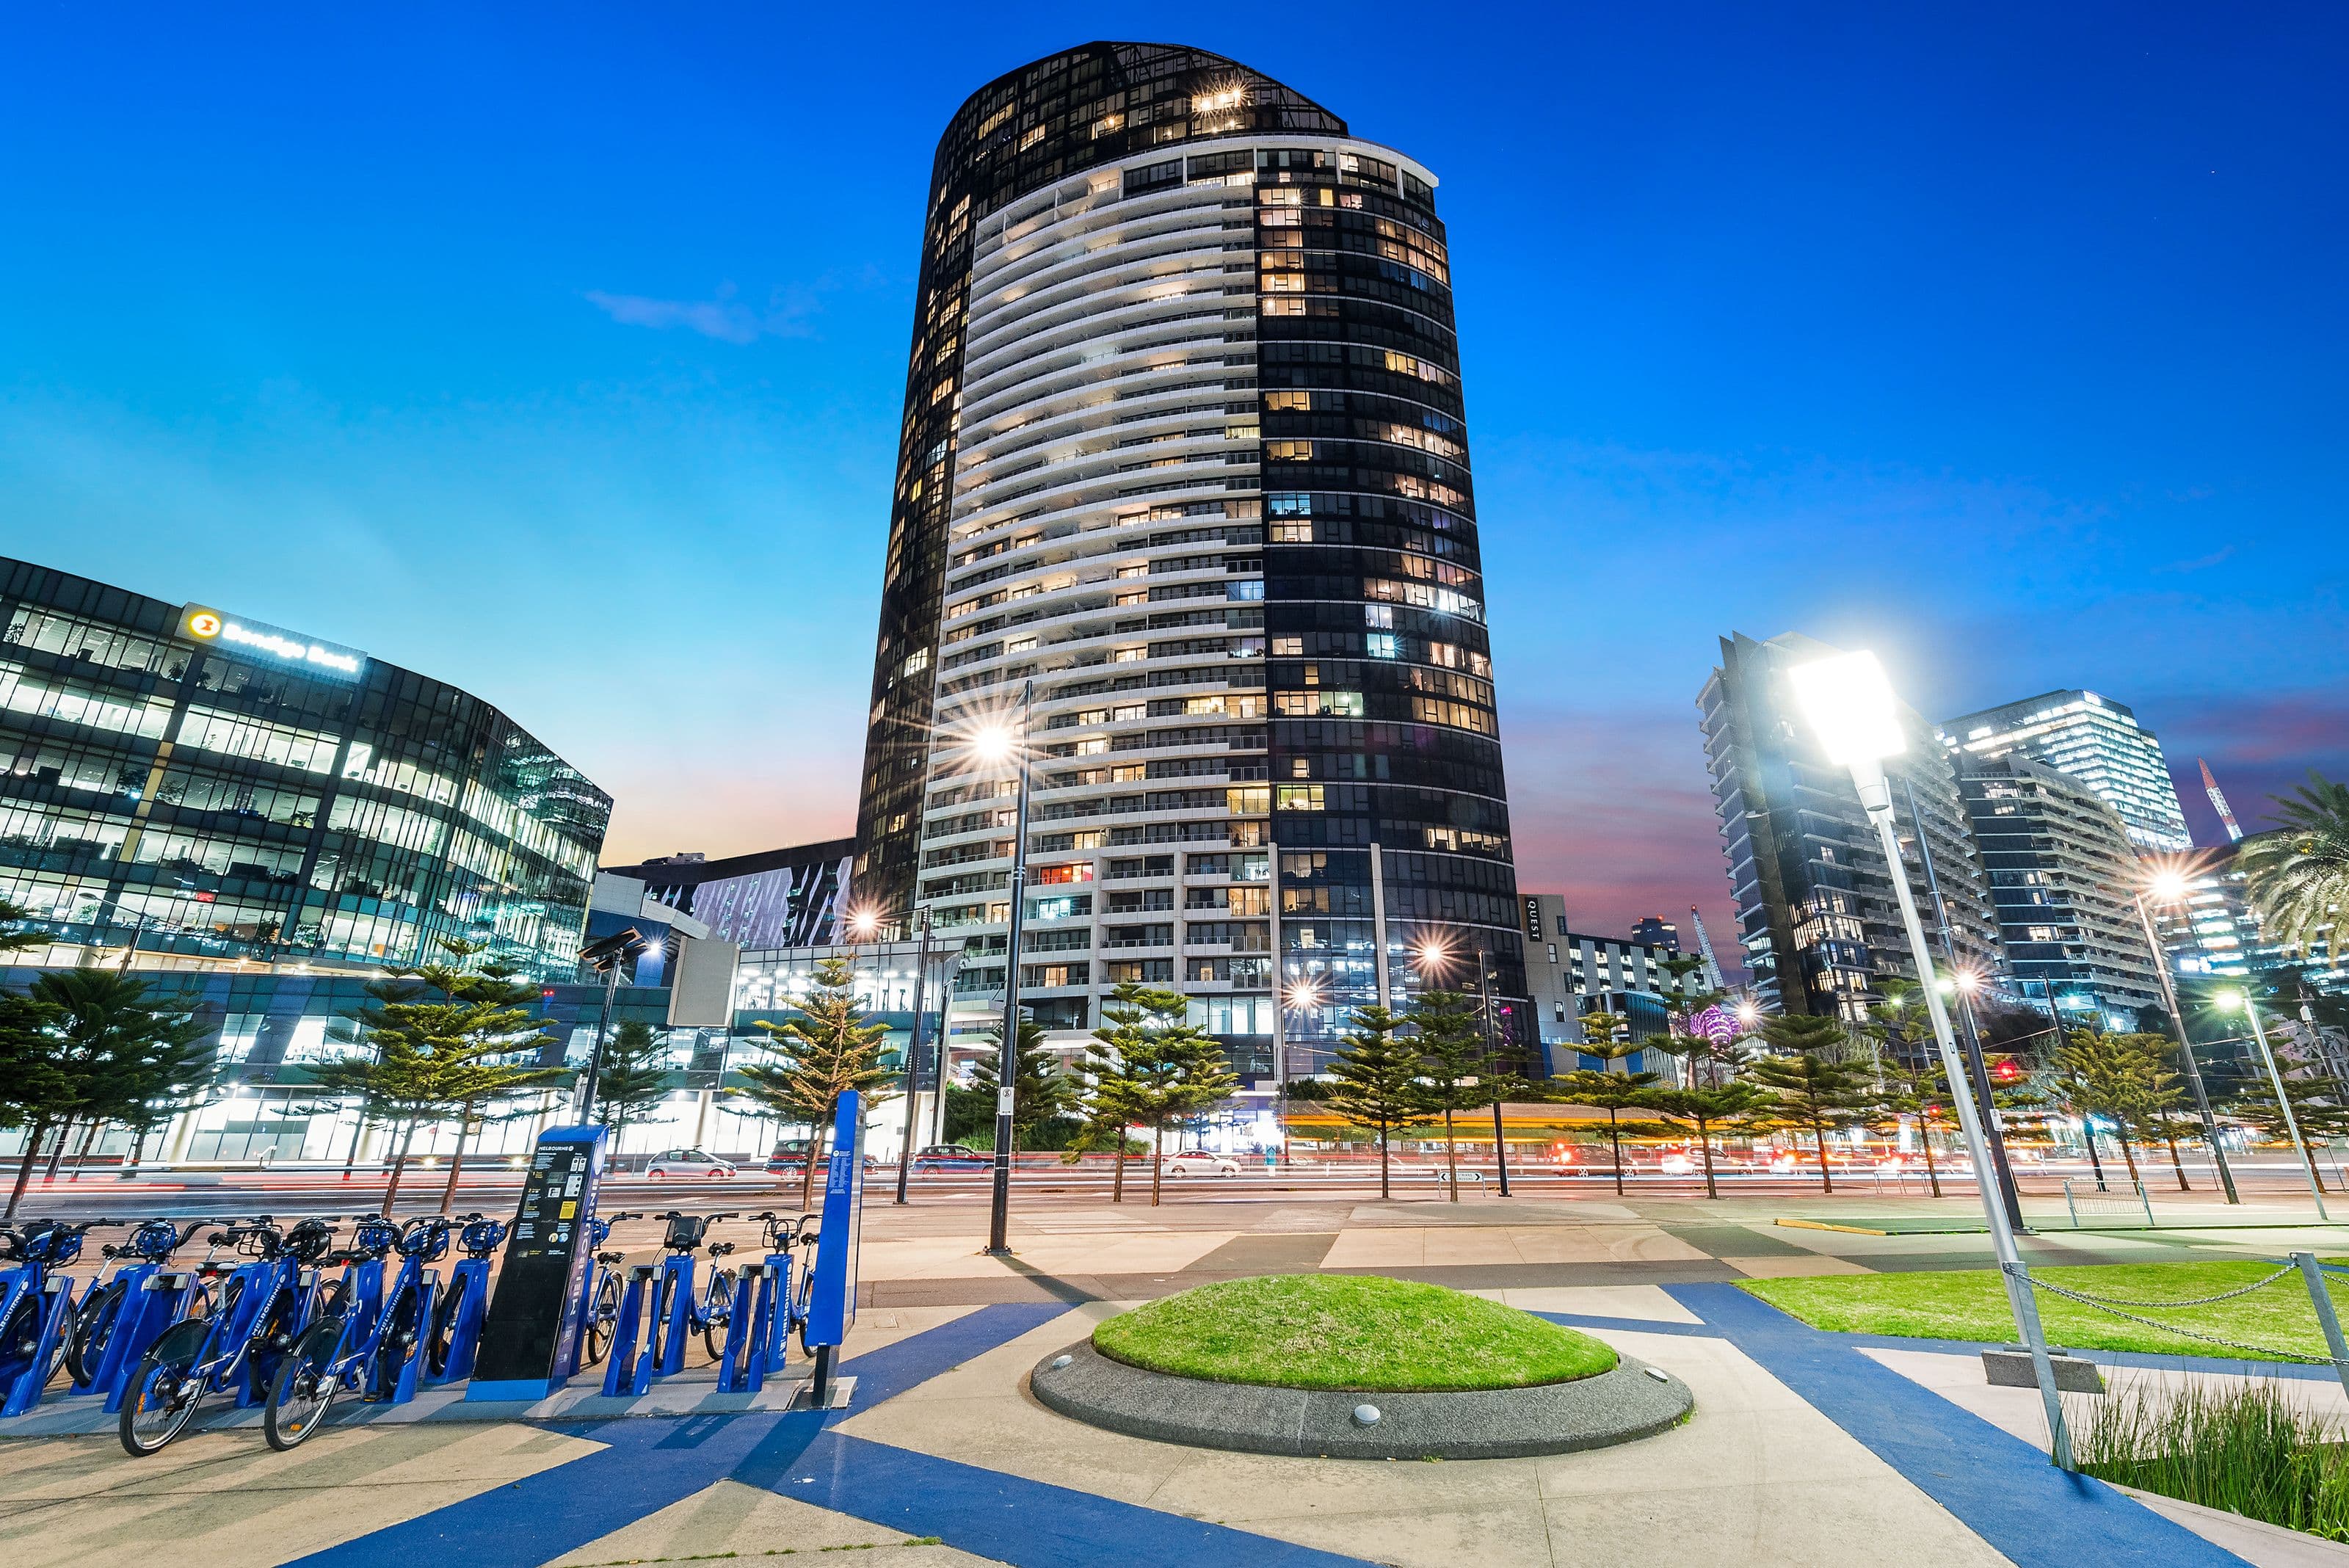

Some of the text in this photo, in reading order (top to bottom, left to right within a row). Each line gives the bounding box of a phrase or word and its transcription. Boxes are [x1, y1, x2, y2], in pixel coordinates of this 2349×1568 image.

[1527, 901, 1539, 938] QUEST
[252, 1282, 282, 1336] MELBOURNE
[378, 1282, 406, 1335] MELBOURNE
[783, 1275, 791, 1337] MELBOURNE
